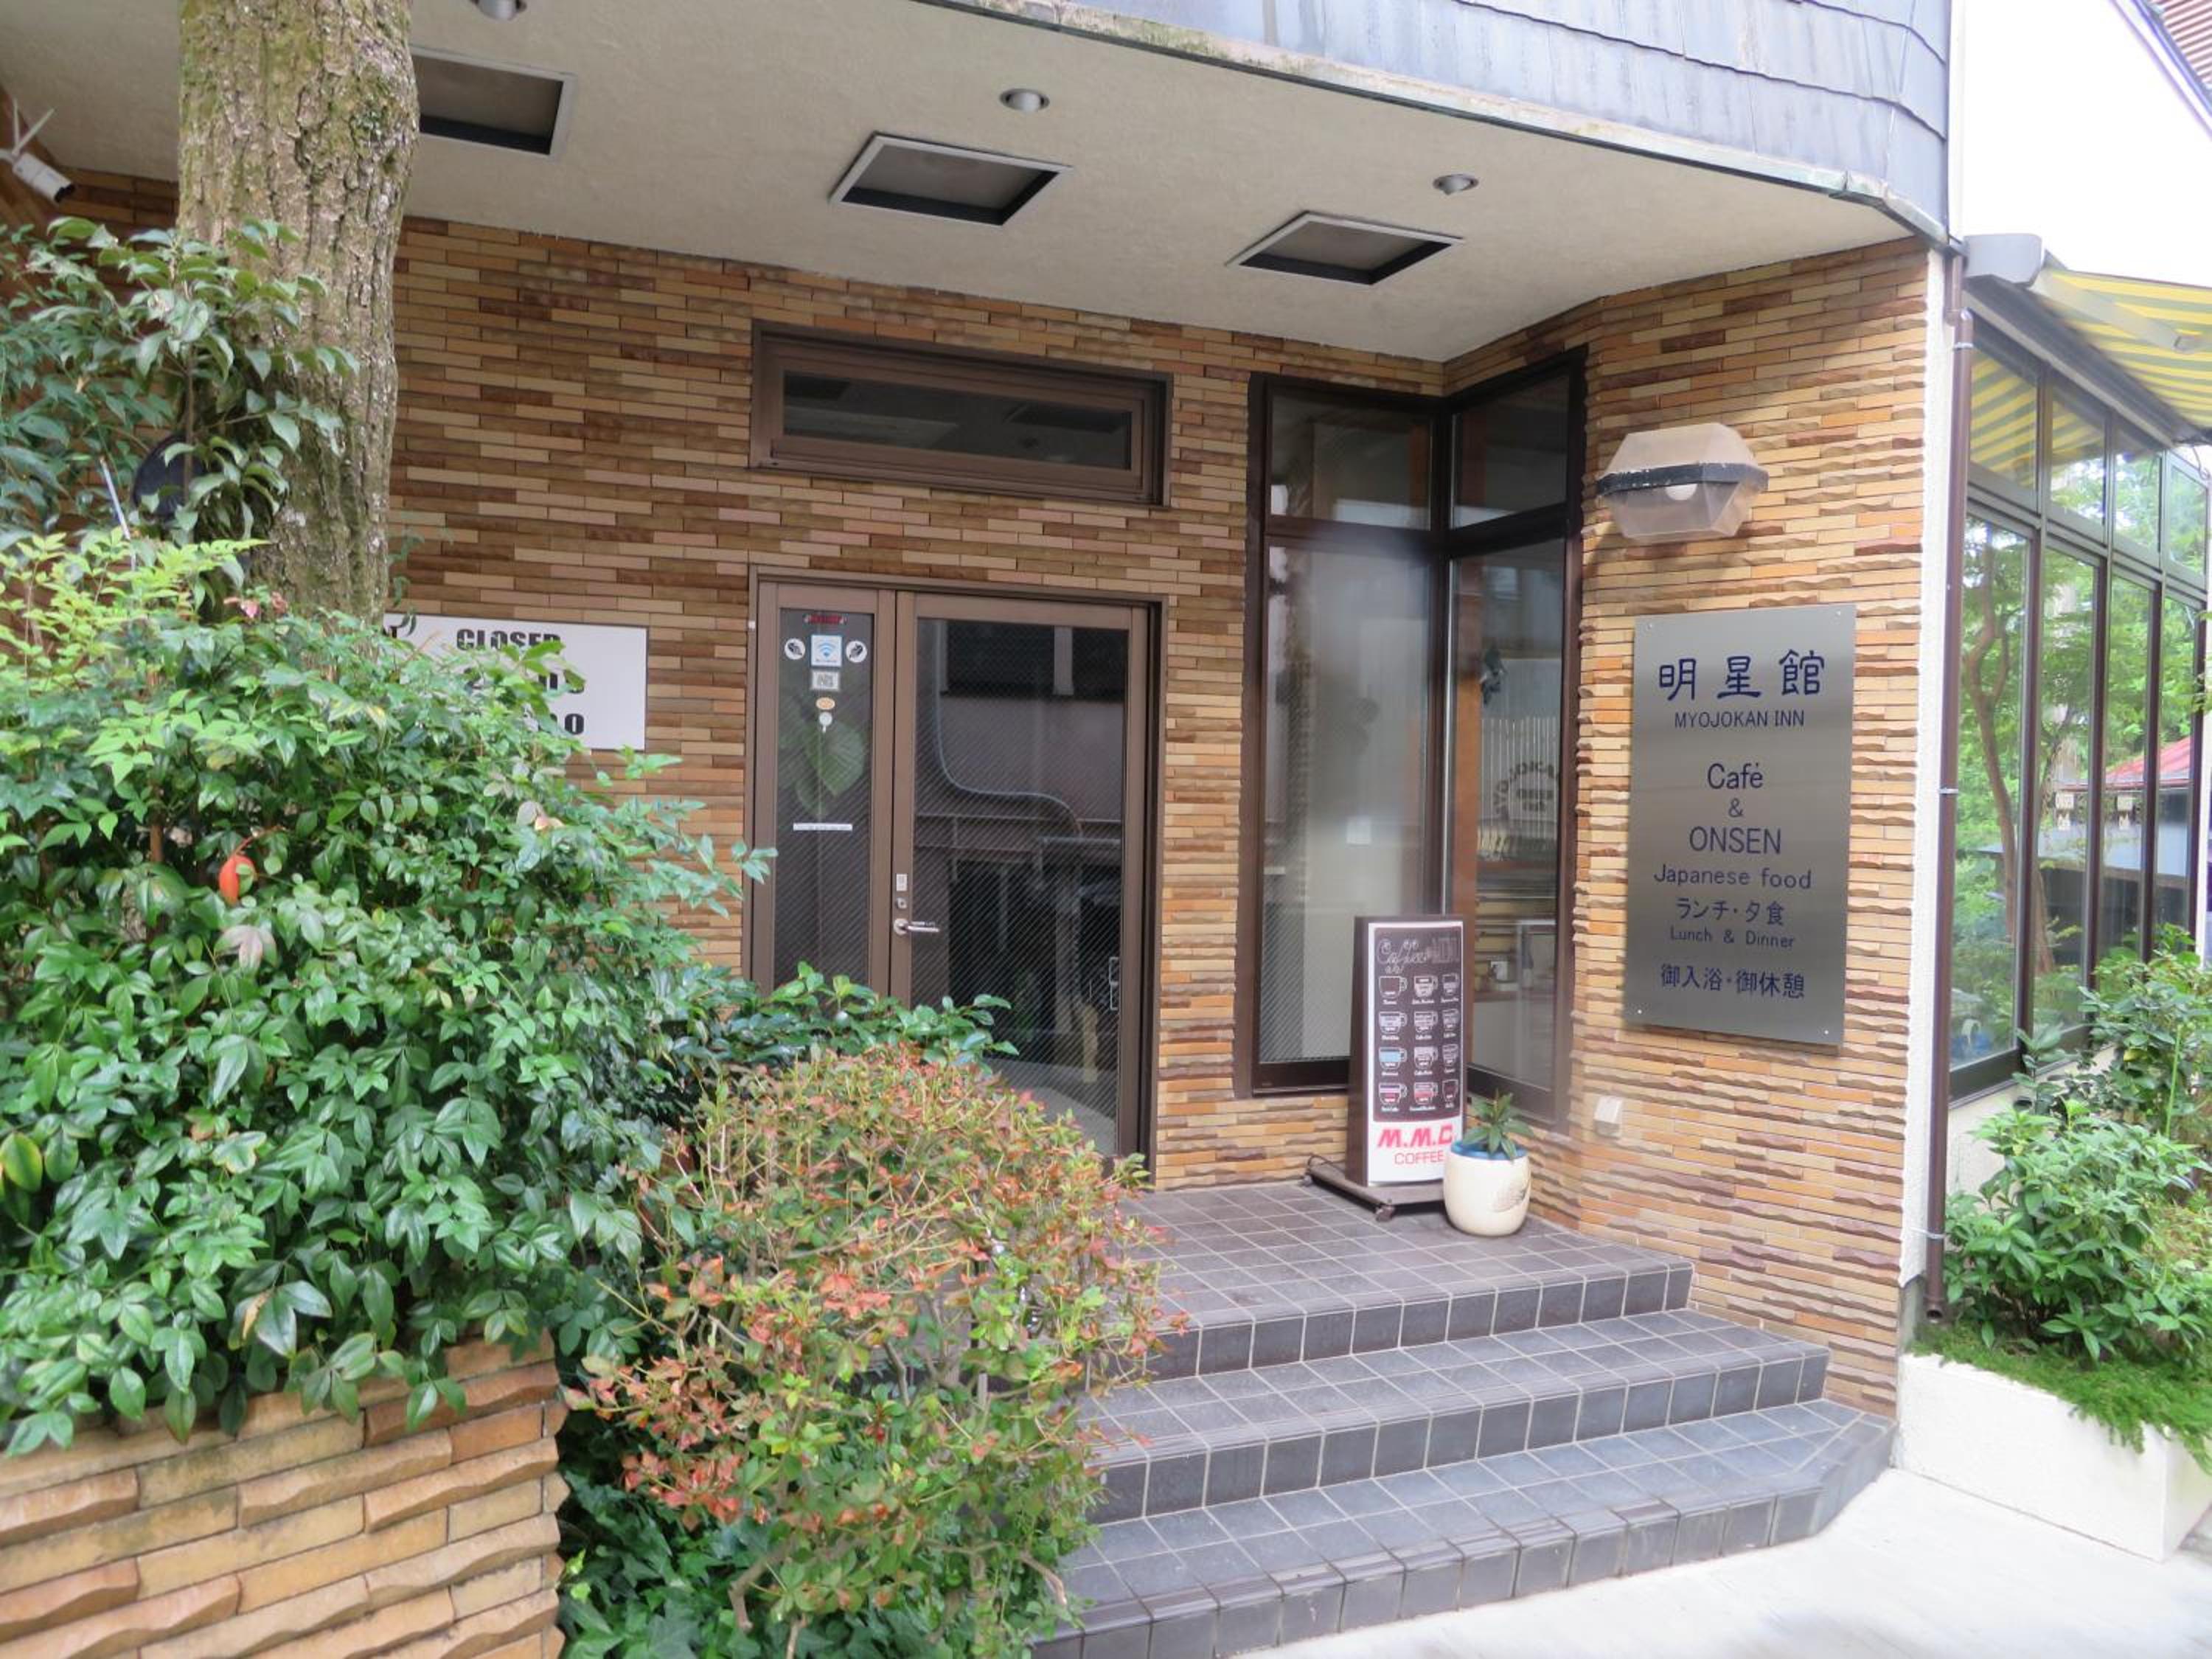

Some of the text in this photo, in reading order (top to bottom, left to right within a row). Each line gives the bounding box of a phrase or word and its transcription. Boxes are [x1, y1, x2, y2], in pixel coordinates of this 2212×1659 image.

[1659, 650, 1824, 700] 明星館
[1674, 710, 1804, 728] MYOJOKAN INN
[1707, 762, 1764, 789] Café
[1728, 798, 1743, 818] &
[1689, 826, 1781, 855] ONSEN
[1653, 864, 1812, 889] Japanese food
[1676, 897, 1784, 925] ランチ・夕食
[1670, 926, 1795, 947] Lunch & Dinner
[1394, 1150, 1444, 1165] COFFEE
